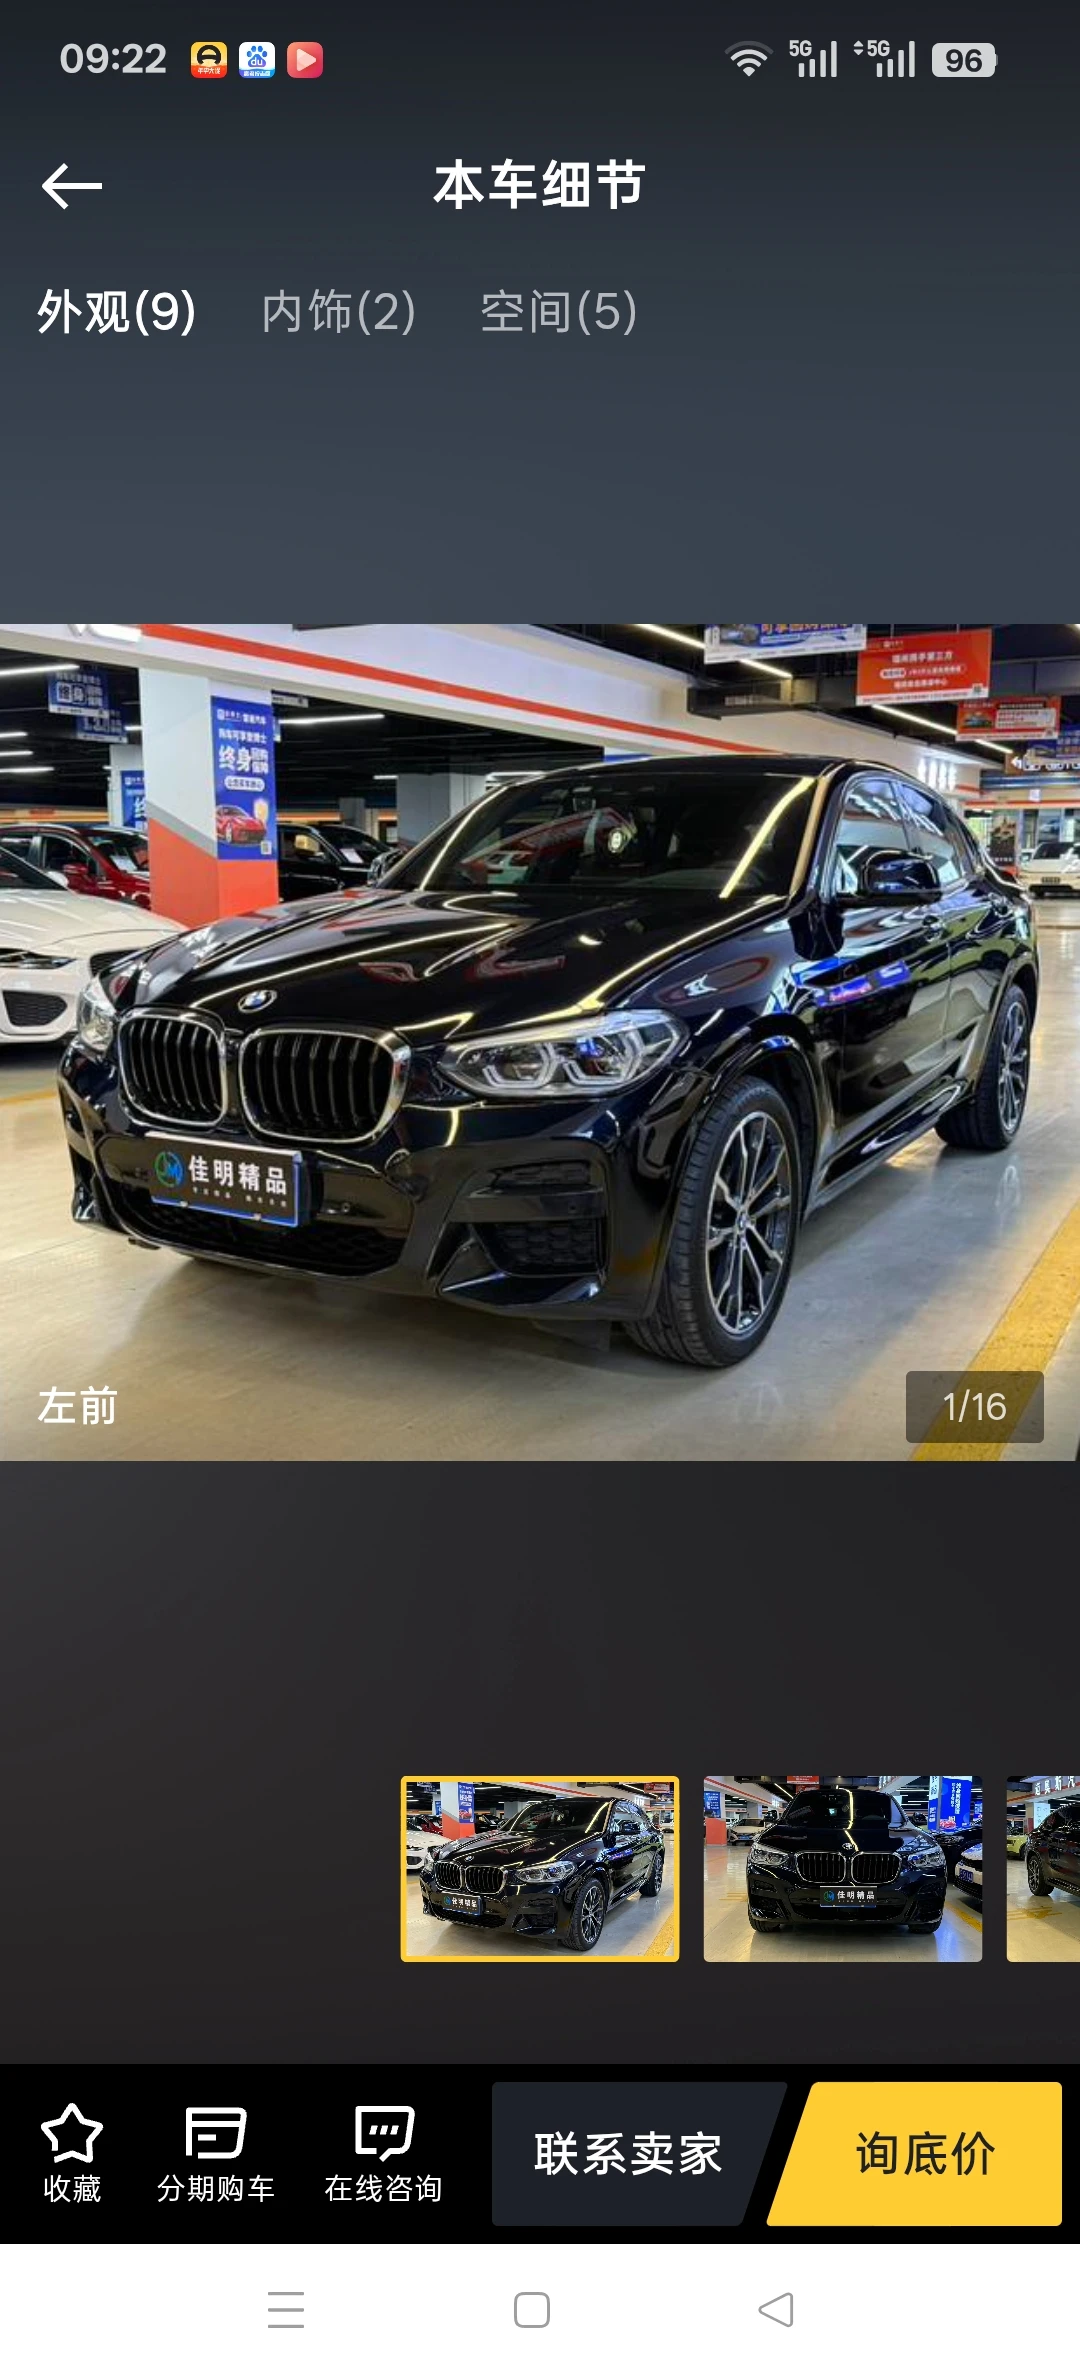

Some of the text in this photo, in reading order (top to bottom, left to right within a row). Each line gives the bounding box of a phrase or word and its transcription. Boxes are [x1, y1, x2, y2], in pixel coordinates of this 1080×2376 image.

[60, 43, 166, 73] 09:22
[789, 40, 812, 56] 5G
[867, 40, 890, 56] 5G
[945, 49, 983, 72] 96
[433, 158, 646, 209] 本车细节
[37, 289, 195, 336] 外观(9)
[263, 289, 415, 336] 内饰(2)
[481, 289, 636, 336] 空间(5)
[219, 745, 251, 772] 终身
[189, 1155, 287, 1195] 佳明精品
[534, 2131, 723, 2176] 联系卖家
[856, 2131, 996, 2176] 询底价
[43, 2174, 102, 2204] 收藏
[157, 2174, 275, 2204] 分期购车
[324, 2174, 442, 2204] 在线咨询
